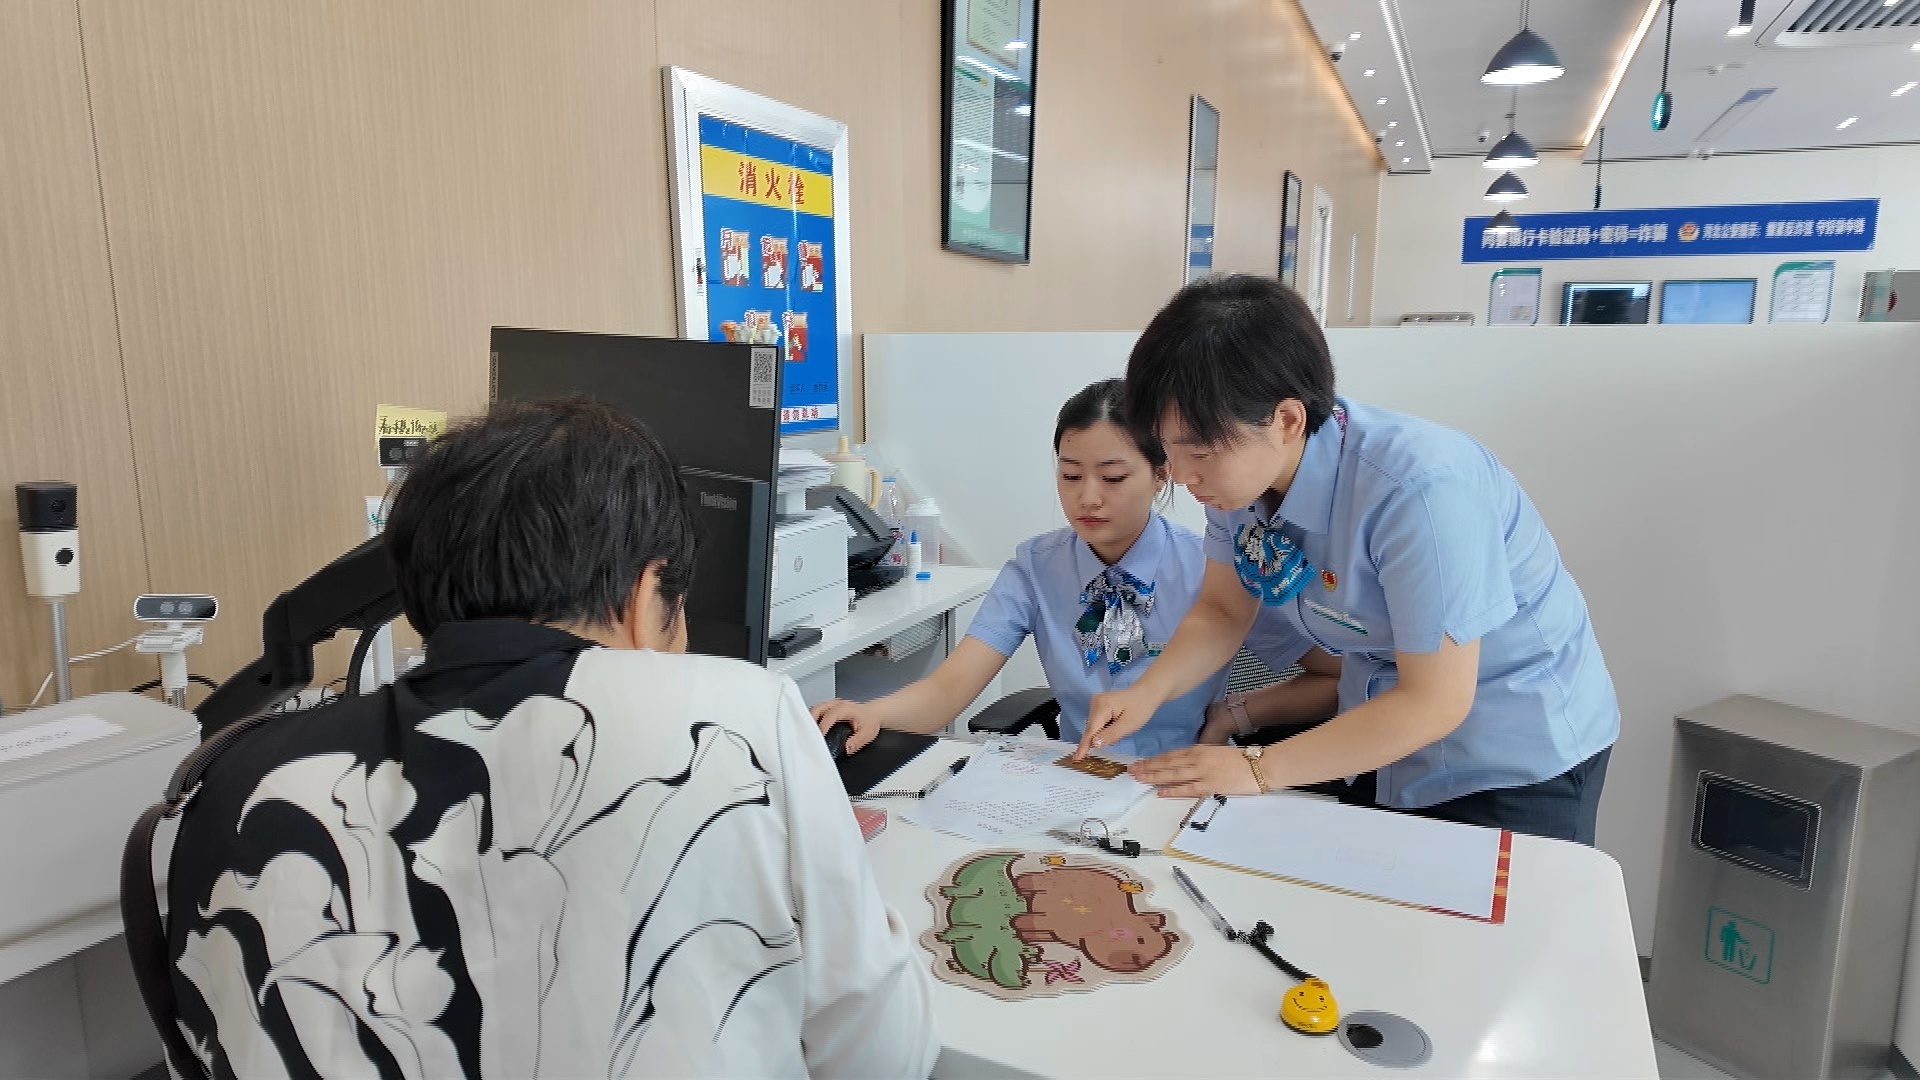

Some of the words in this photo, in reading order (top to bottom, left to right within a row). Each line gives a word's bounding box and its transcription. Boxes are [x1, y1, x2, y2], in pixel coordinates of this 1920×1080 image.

[738, 161, 805, 205] 消火栓
[782, 405, 820, 422] 请勿乱动
